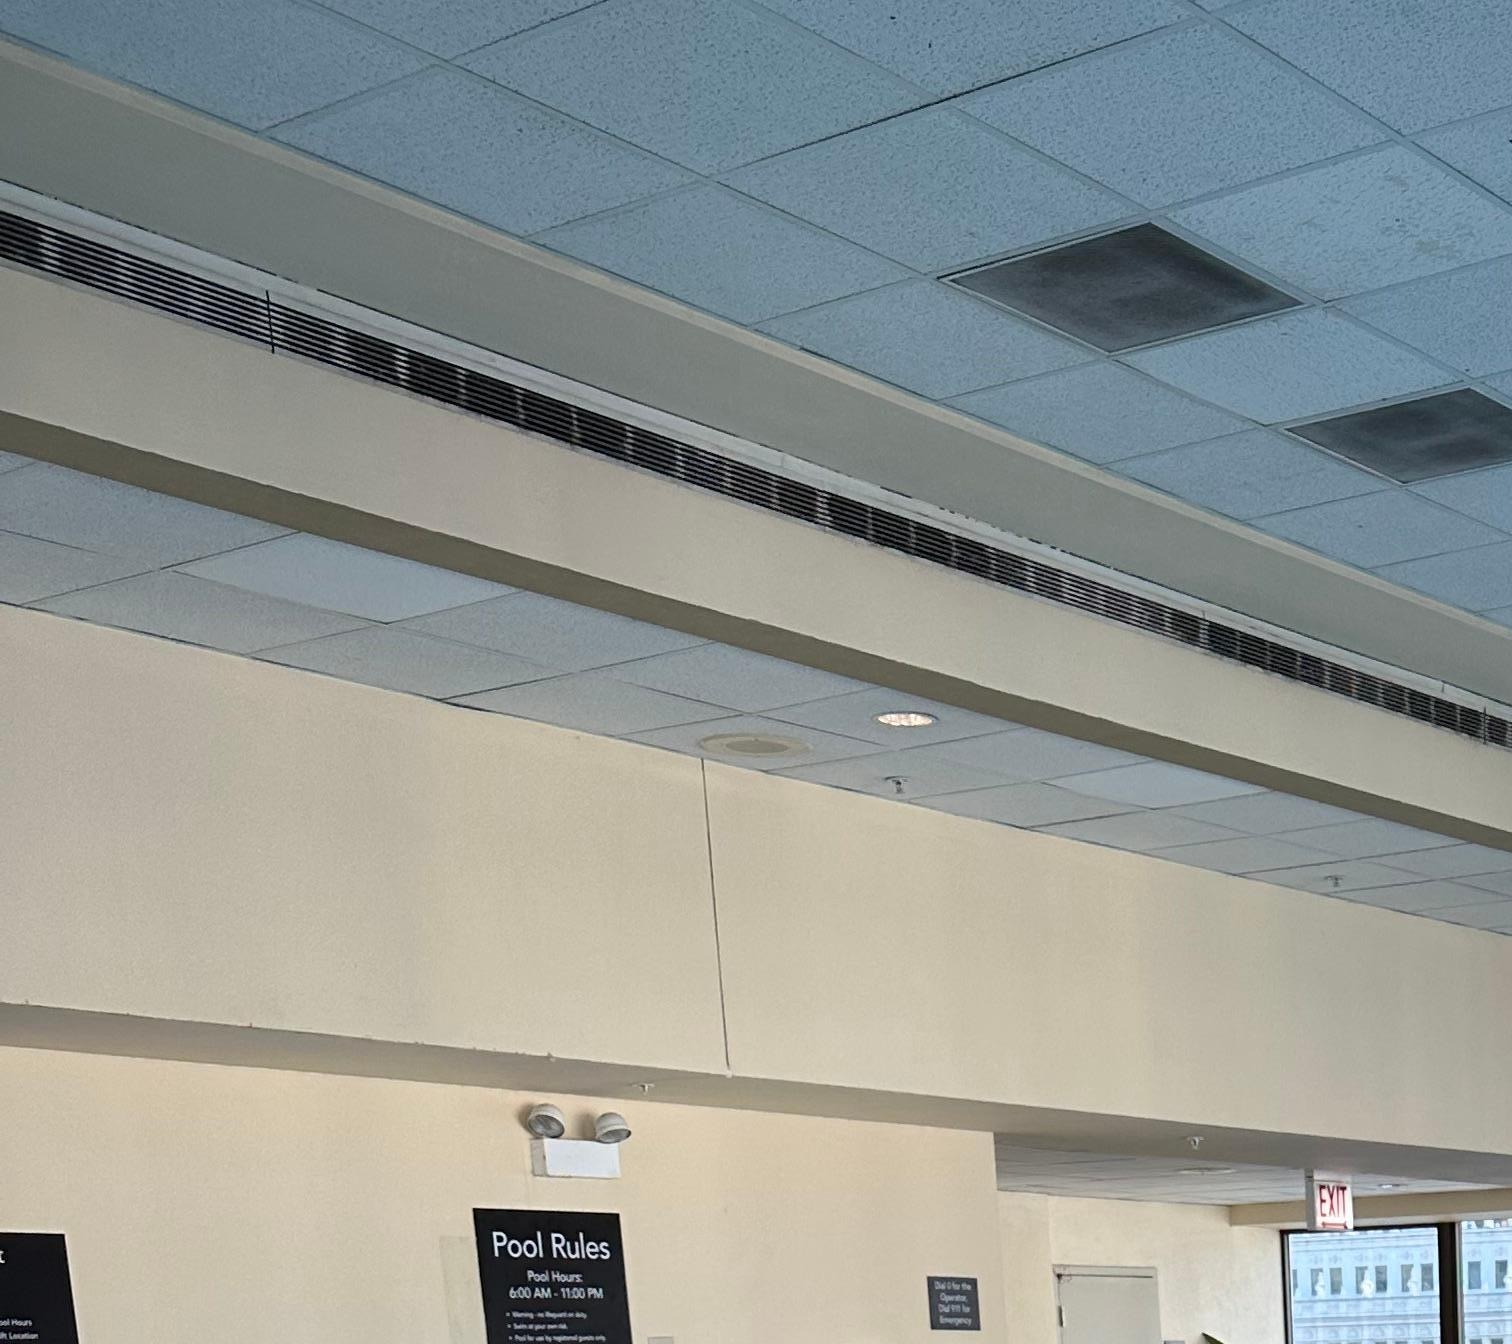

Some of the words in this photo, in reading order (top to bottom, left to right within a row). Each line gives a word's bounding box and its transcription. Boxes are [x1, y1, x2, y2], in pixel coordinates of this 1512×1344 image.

[1319, 1184, 1347, 1217] EXIT
[492, 1231, 543, 1258] Pool
[551, 1232, 611, 1260] Rules
[527, 1269, 549, 1283] Pool
[551, 1271, 583, 1283] Hours:
[509, 1287, 532, 1299] 6:00
[533, 1287, 552, 1299] AM
[560, 1287, 585, 1299] 11:00
[588, 1287, 604, 1299] PM
[0, 1318, 10, 1327] ool
[11, 1318, 32, 1327] Hours
[9, 1332, 39, 1340] Location
